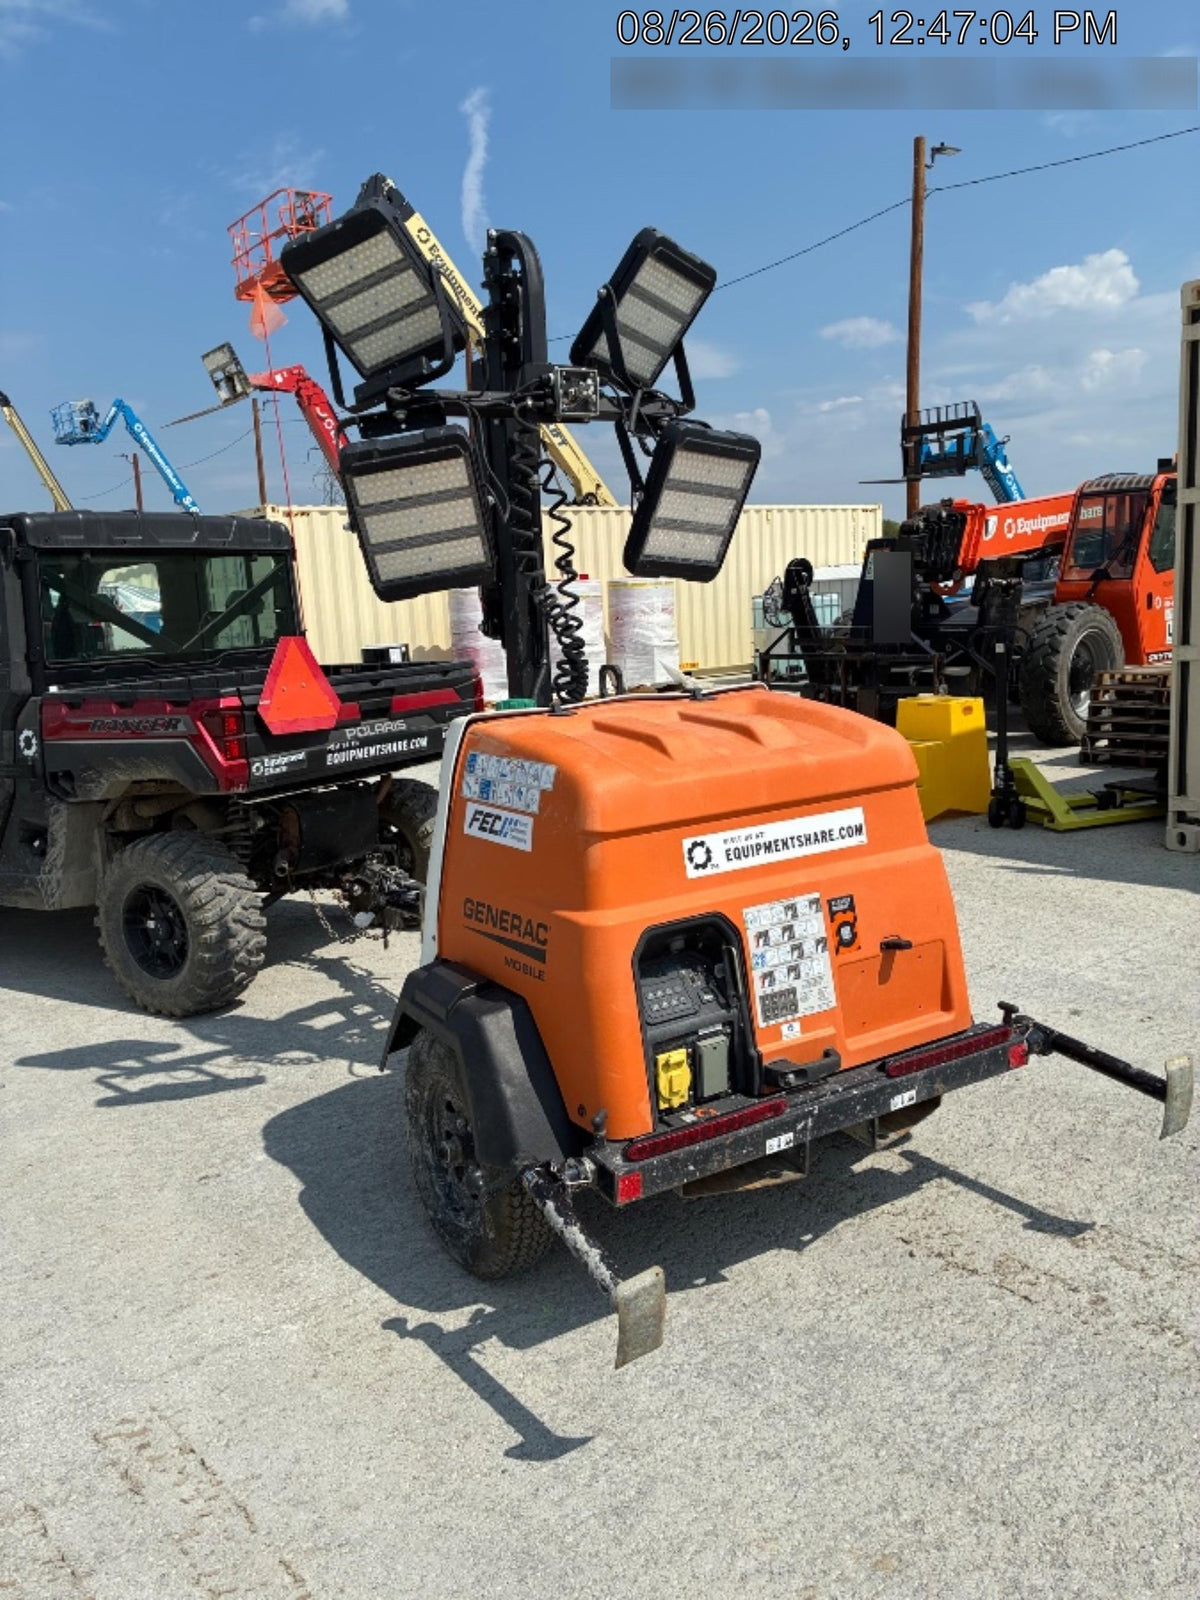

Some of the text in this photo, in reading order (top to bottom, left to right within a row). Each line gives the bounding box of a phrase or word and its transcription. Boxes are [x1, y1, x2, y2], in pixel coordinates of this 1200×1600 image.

[90, 718, 181, 732] RANGER
[345, 719, 407, 739] POLARIS
[326, 736, 428, 766] EQUIPMENTSHARE.COM
[468, 809, 502, 836] FEC
[725, 823, 864, 862] EQUIPMENTSHARE.COM
[463, 897, 549, 946] GENERAC
[504, 956, 545, 981] MOBILE
